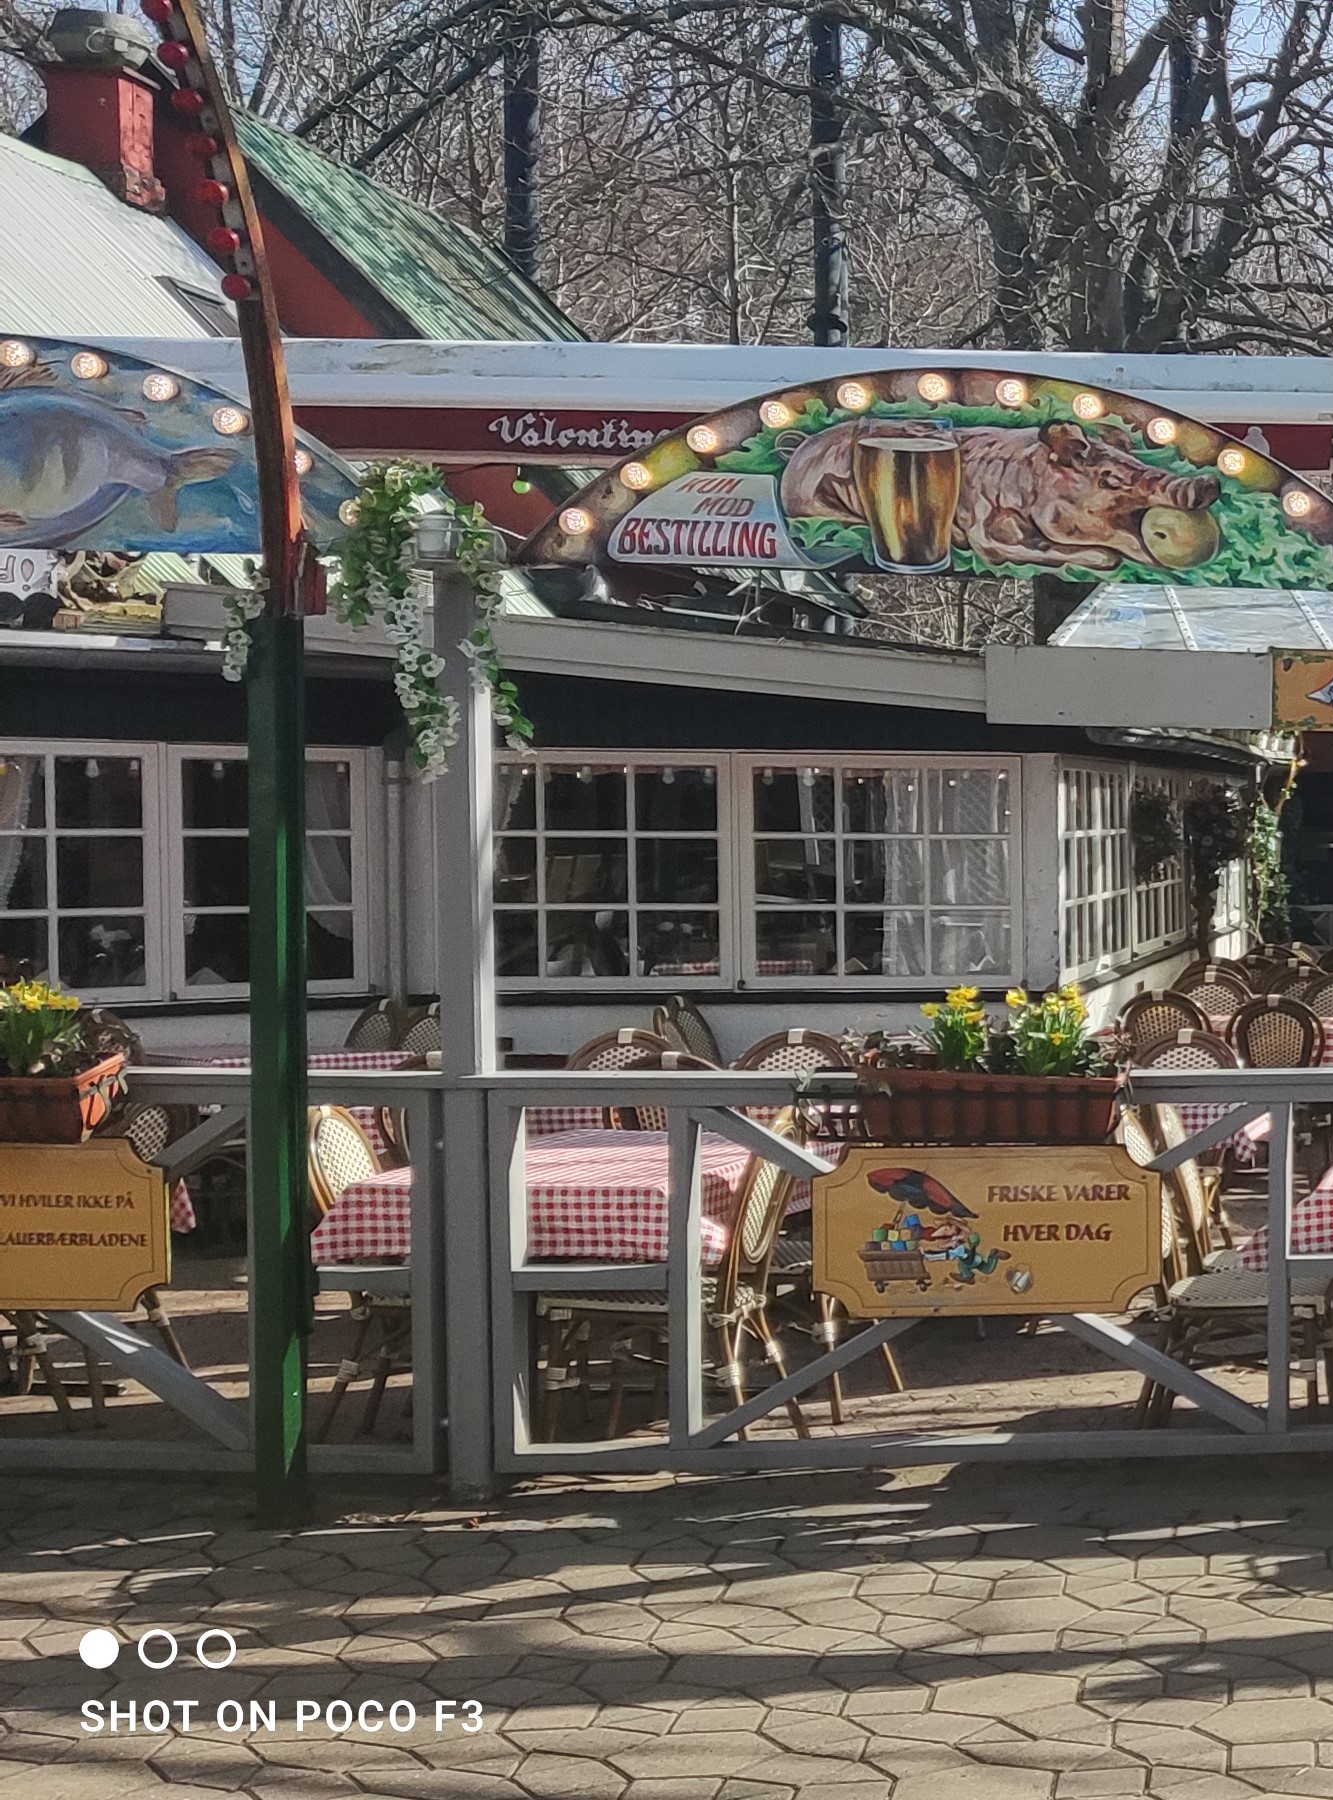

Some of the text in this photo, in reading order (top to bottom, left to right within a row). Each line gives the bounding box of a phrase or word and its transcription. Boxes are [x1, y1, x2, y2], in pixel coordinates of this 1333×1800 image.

[488, 412, 671, 449] Valentin
[692, 497, 755, 517] MOD
[617, 518, 777, 559] BESTILLING
[18, 1194, 74, 1209] HVILER
[77, 1195, 113, 1209] IKKE
[116, 1191, 135, 1209] PÅ
[987, 1183, 1131, 1203] FRISKE VARER
[1003, 1223, 1114, 1242] HVER DAG
